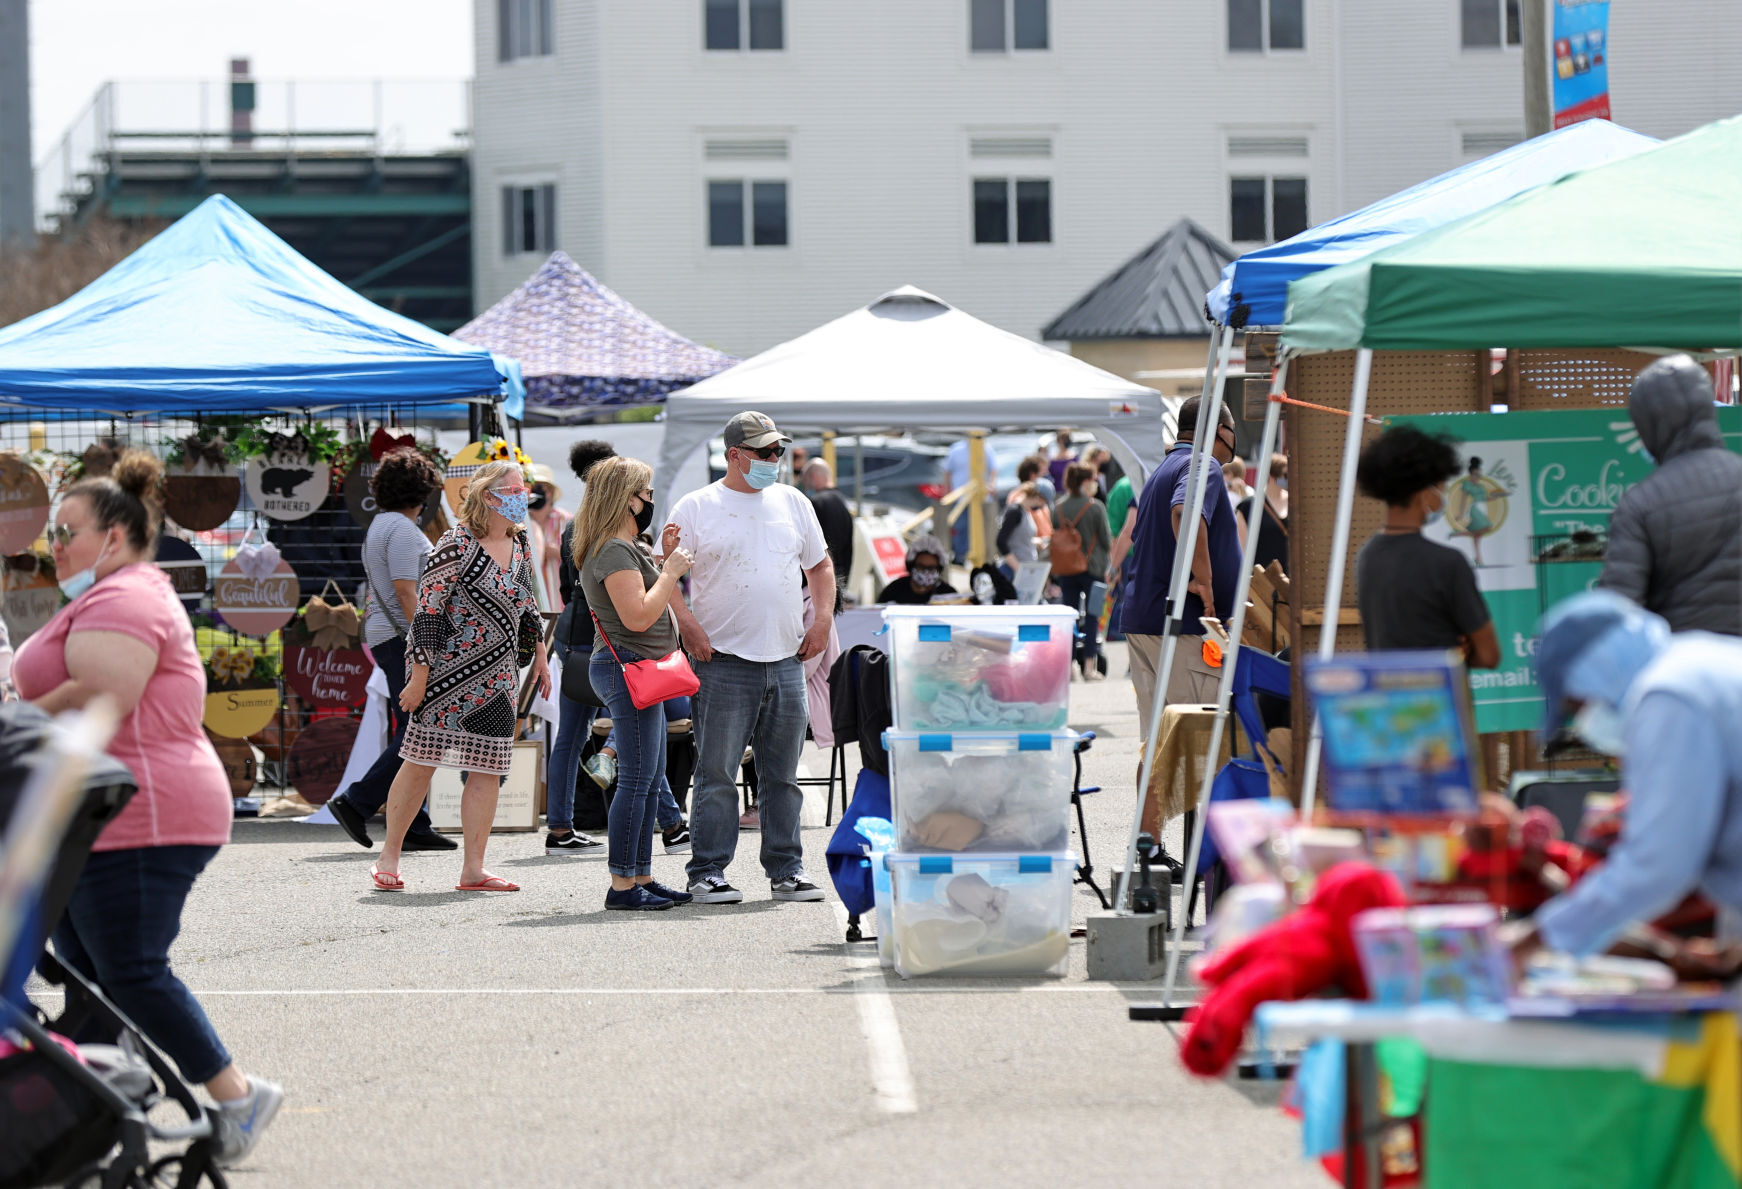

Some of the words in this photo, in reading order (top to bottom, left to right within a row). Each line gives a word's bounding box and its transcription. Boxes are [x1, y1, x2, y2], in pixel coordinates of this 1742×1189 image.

[264, 500, 311, 512] BOTHERED
[220, 579, 290, 606] beautiful
[297, 647, 364, 678] Welcome
[311, 672, 350, 702] home
[226, 692, 274, 712] Summer
